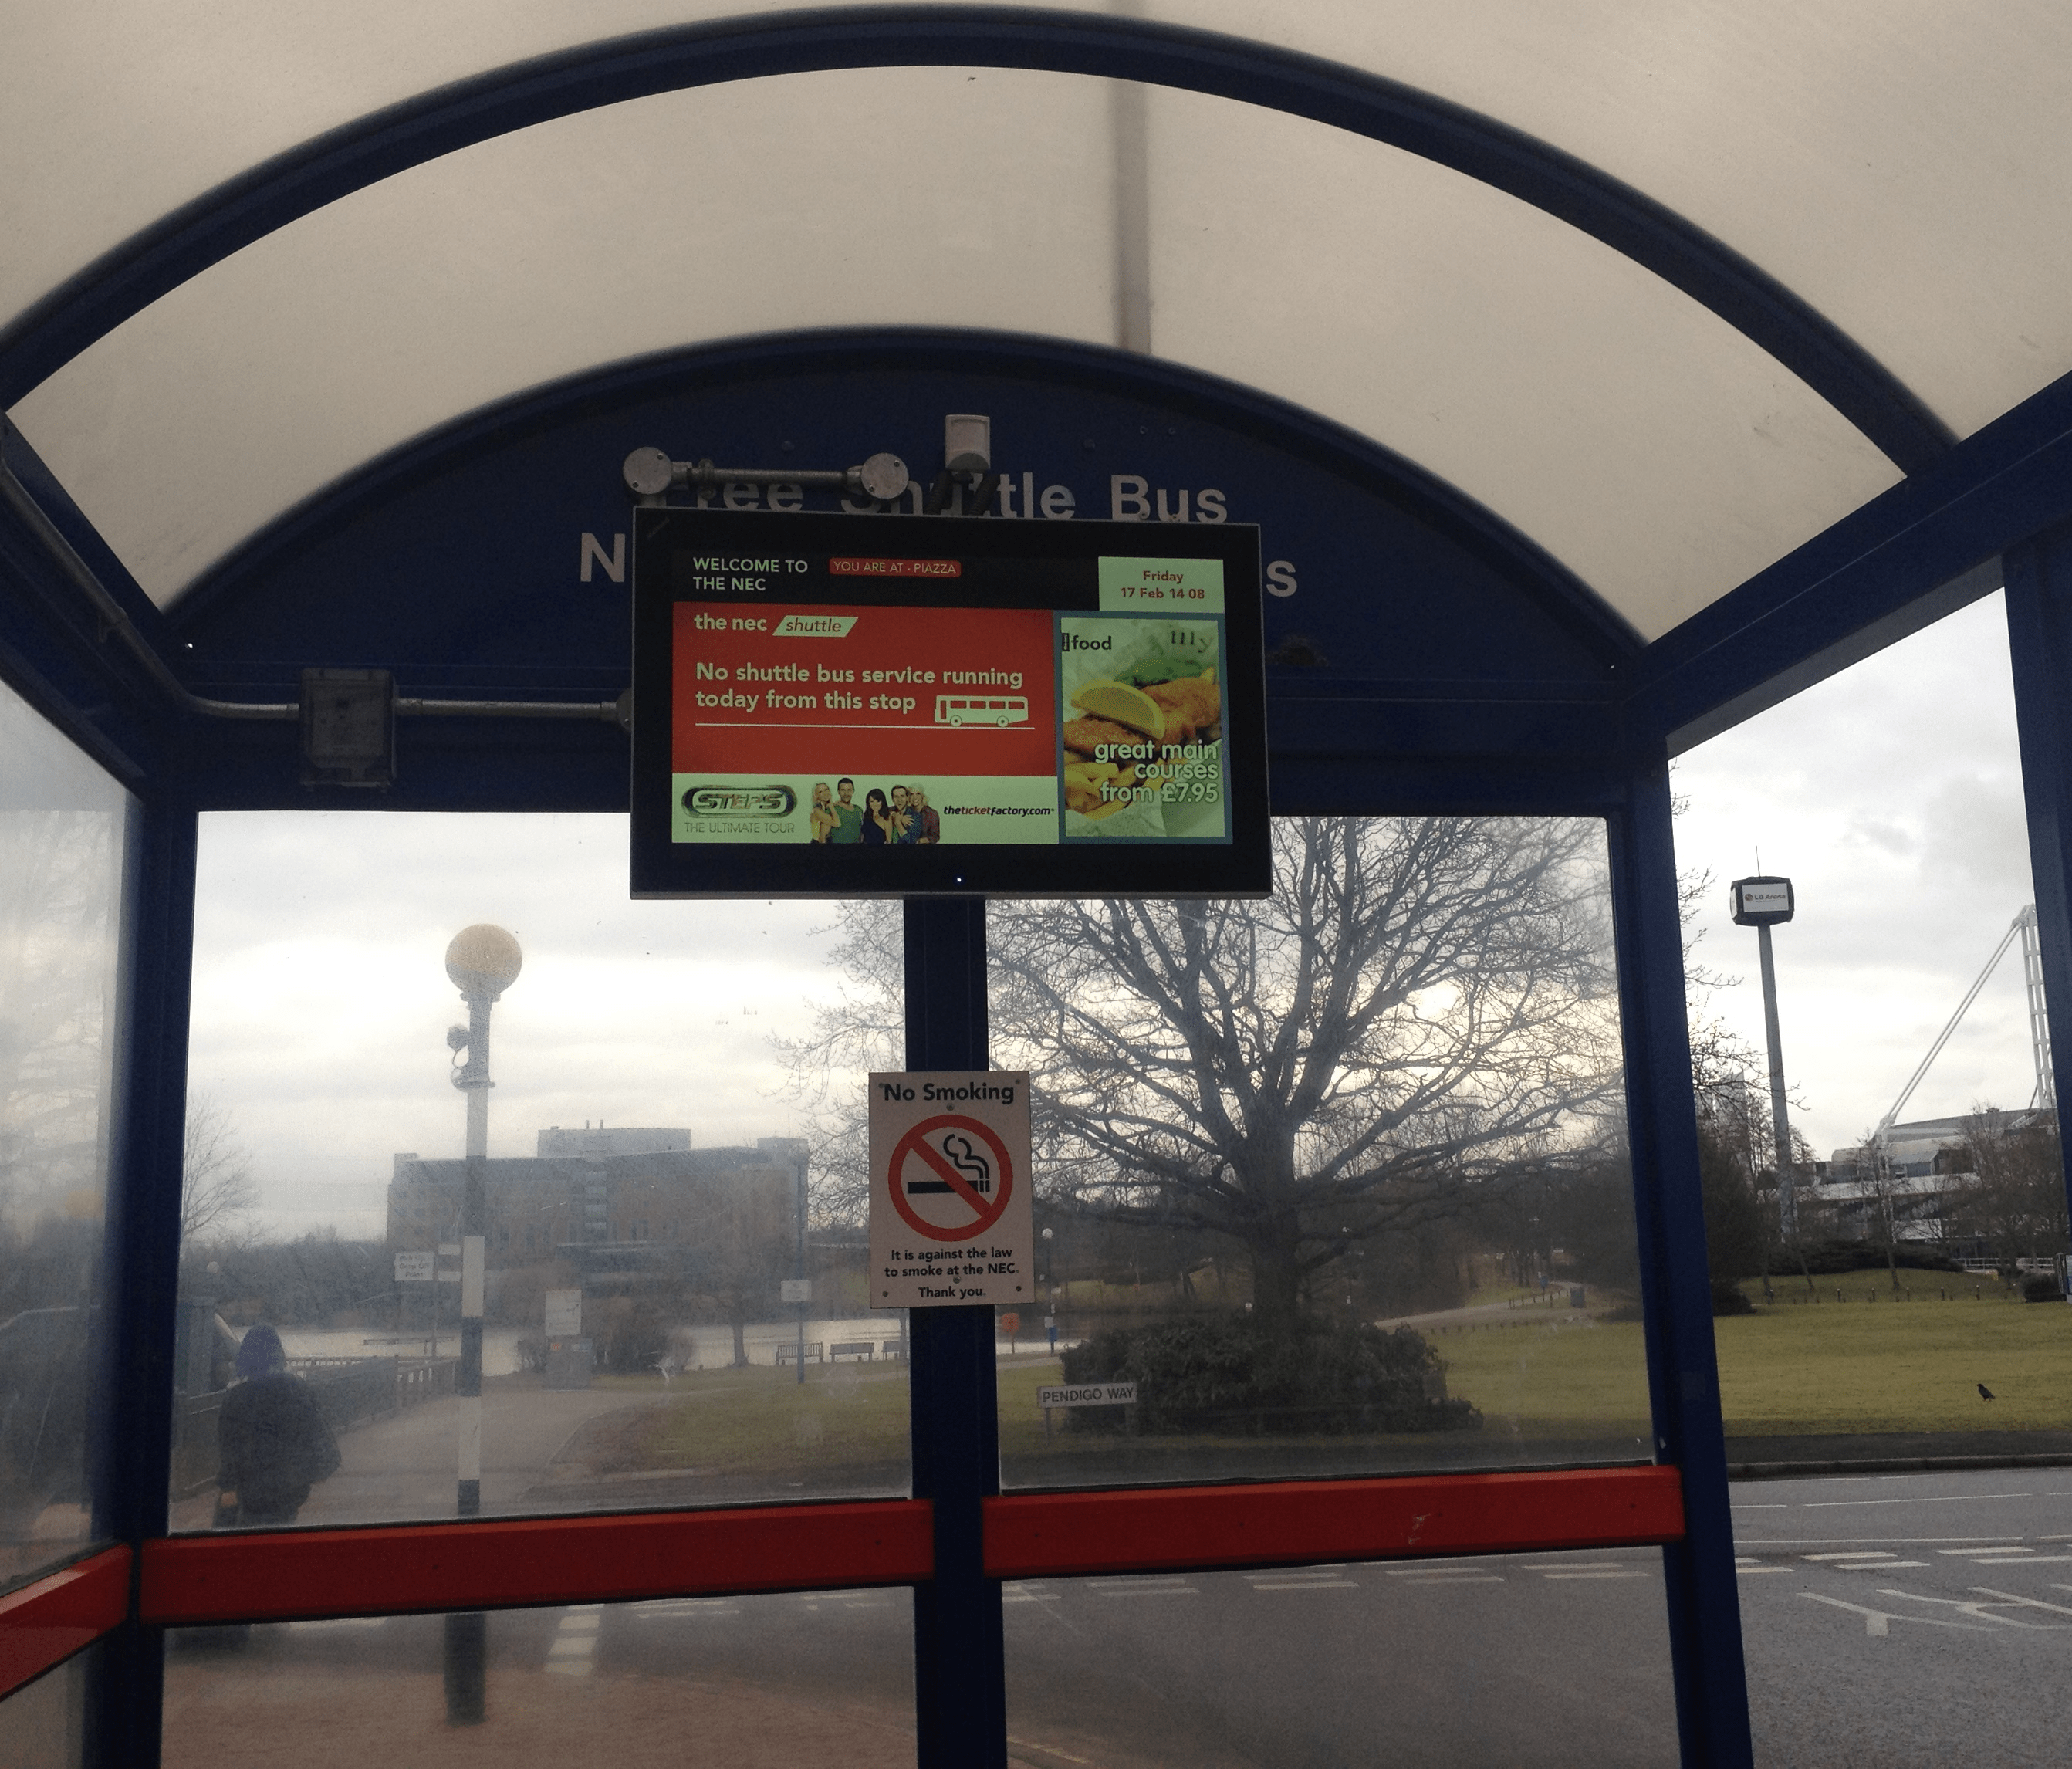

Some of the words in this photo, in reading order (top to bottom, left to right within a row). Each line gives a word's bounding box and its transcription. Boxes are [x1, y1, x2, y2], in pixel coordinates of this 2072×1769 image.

[1111, 475, 1228, 523] Bus
[693, 557, 779, 572] WELCOME
[785, 560, 808, 573] TO
[833, 561, 860, 571] YOU
[863, 562, 886, 572] ARE
[889, 563, 904, 573] AT
[914, 563, 956, 573] PIAZZA
[693, 577, 725, 590] THE
[731, 577, 766, 590] NEC
[1143, 570, 1184, 584] Friday
[1120, 587, 1135, 598] 17
[1140, 587, 1164, 599] Feb
[1169, 588, 1185, 599] 14
[1188, 589, 1205, 600] 08
[695, 613, 727, 630] the
[732, 618, 767, 631] nec
[786, 617, 842, 633] shuttle
[1071, 635, 1112, 651] food
[696, 663, 728, 681] No
[736, 663, 810, 682] shuttle
[817, 665, 854, 683] bus
[862, 666, 935, 685] service
[943, 668, 1023, 689] running
[696, 689, 759, 712] today
[766, 689, 817, 709] from
[824, 691, 863, 709] this
[870, 694, 916, 714] stop
[1094, 741, 1155, 764] great
[1161, 739, 1218, 760] main
[1134, 763, 1219, 780] courses
[1100, 782, 1154, 802] from
[1161, 783, 1219, 803] £7.95
[684, 823, 705, 833] THE
[709, 822, 760, 834] ULTIMATE
[764, 823, 795, 834] TOUR
[884, 1084, 915, 1101] No
[923, 1082, 1014, 1104] Smoking
[891, 1250, 901, 1260] It
[904, 1250, 914, 1260] is
[918, 1249, 963, 1262] against
[966, 1247, 987, 1258] the
[992, 1247, 1012, 1258] law
[884, 1267, 898, 1277] to
[902, 1265, 943, 1277] smoke
[947, 1266, 959, 1275] at
[963, 1263, 984, 1274] the
[988, 1263, 1019, 1274] NEC.
[918, 1286, 956, 1298] Thank
[960, 1287, 986, 1300] you.
[1043, 1388, 1102, 1402] PENDIGO
[1107, 1388, 1134, 1399] WAY
